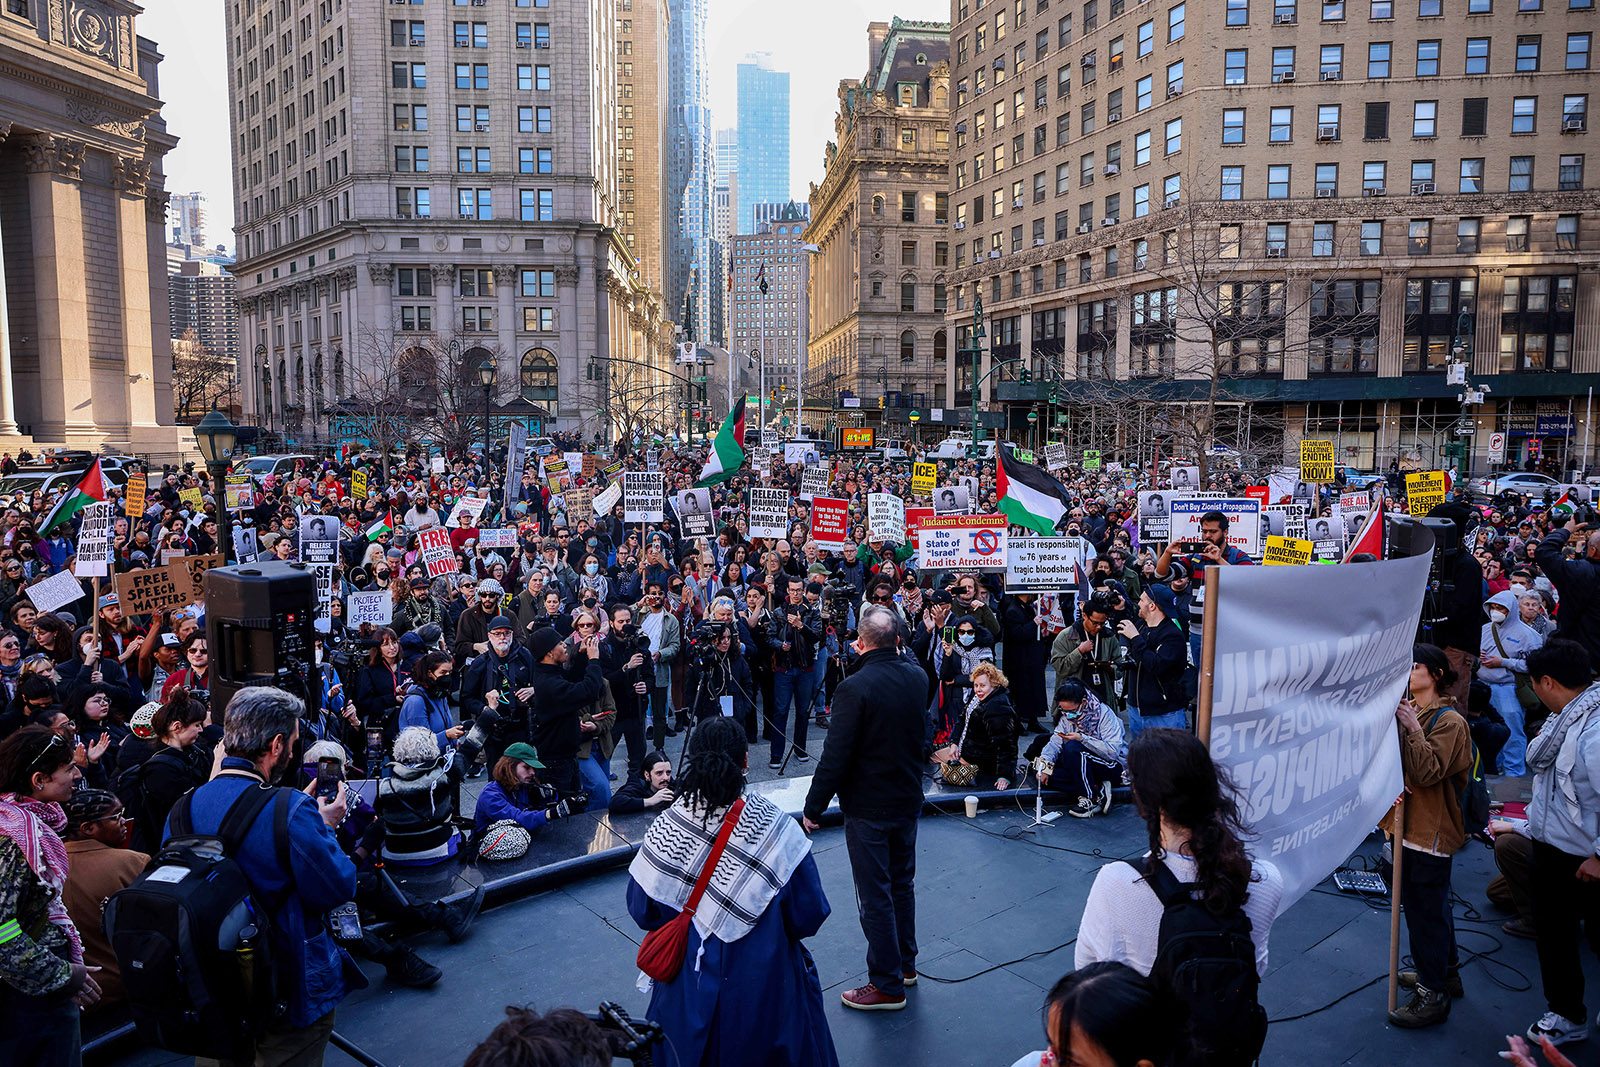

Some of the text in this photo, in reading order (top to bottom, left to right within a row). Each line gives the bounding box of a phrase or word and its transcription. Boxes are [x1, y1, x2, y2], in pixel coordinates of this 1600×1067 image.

[1303, 453, 1332, 461] END THE
[915, 465, 934, 477] ICE:
[1303, 468, 1332, 479] NOW!
[626, 474, 662, 482] RELEASE
[1408, 480, 1442, 489] MOVEMENT
[752, 490, 787, 499] RELEASE
[1410, 495, 1443, 504] PALESTINE
[752, 499, 787, 507] MAHMOUD
[1341, 496, 1368, 507] FREE ALL
[1190, 504, 1200, 512] Buy
[1223, 503, 1256, 511] Propaganda
[1411, 504, 1419, 513] IS
[922, 516, 1004, 526] Judaism Condemns
[1287, 528, 1304, 538] OFF
[1008, 540, 1026, 548] srael
[1037, 540, 1079, 550] responsible
[1283, 539, 1296, 549] THE
[1039, 553, 1059, 562] years
[1267, 546, 1309, 560] MOVEMENT
[926, 557, 1002, 567] And its Atrocities
[1266, 555, 1292, 563] CONTINUES
[189, 559, 217, 572] RE
[1014, 565, 1074, 575] tragic bloodshed
[133, 572, 168, 587] FREE
[128, 583, 175, 601] SPEECH
[133, 592, 186, 613] MATTERS
[354, 595, 383, 605] PROTECT
[358, 604, 379, 613] FREE
[352, 613, 384, 623] SPEECH
